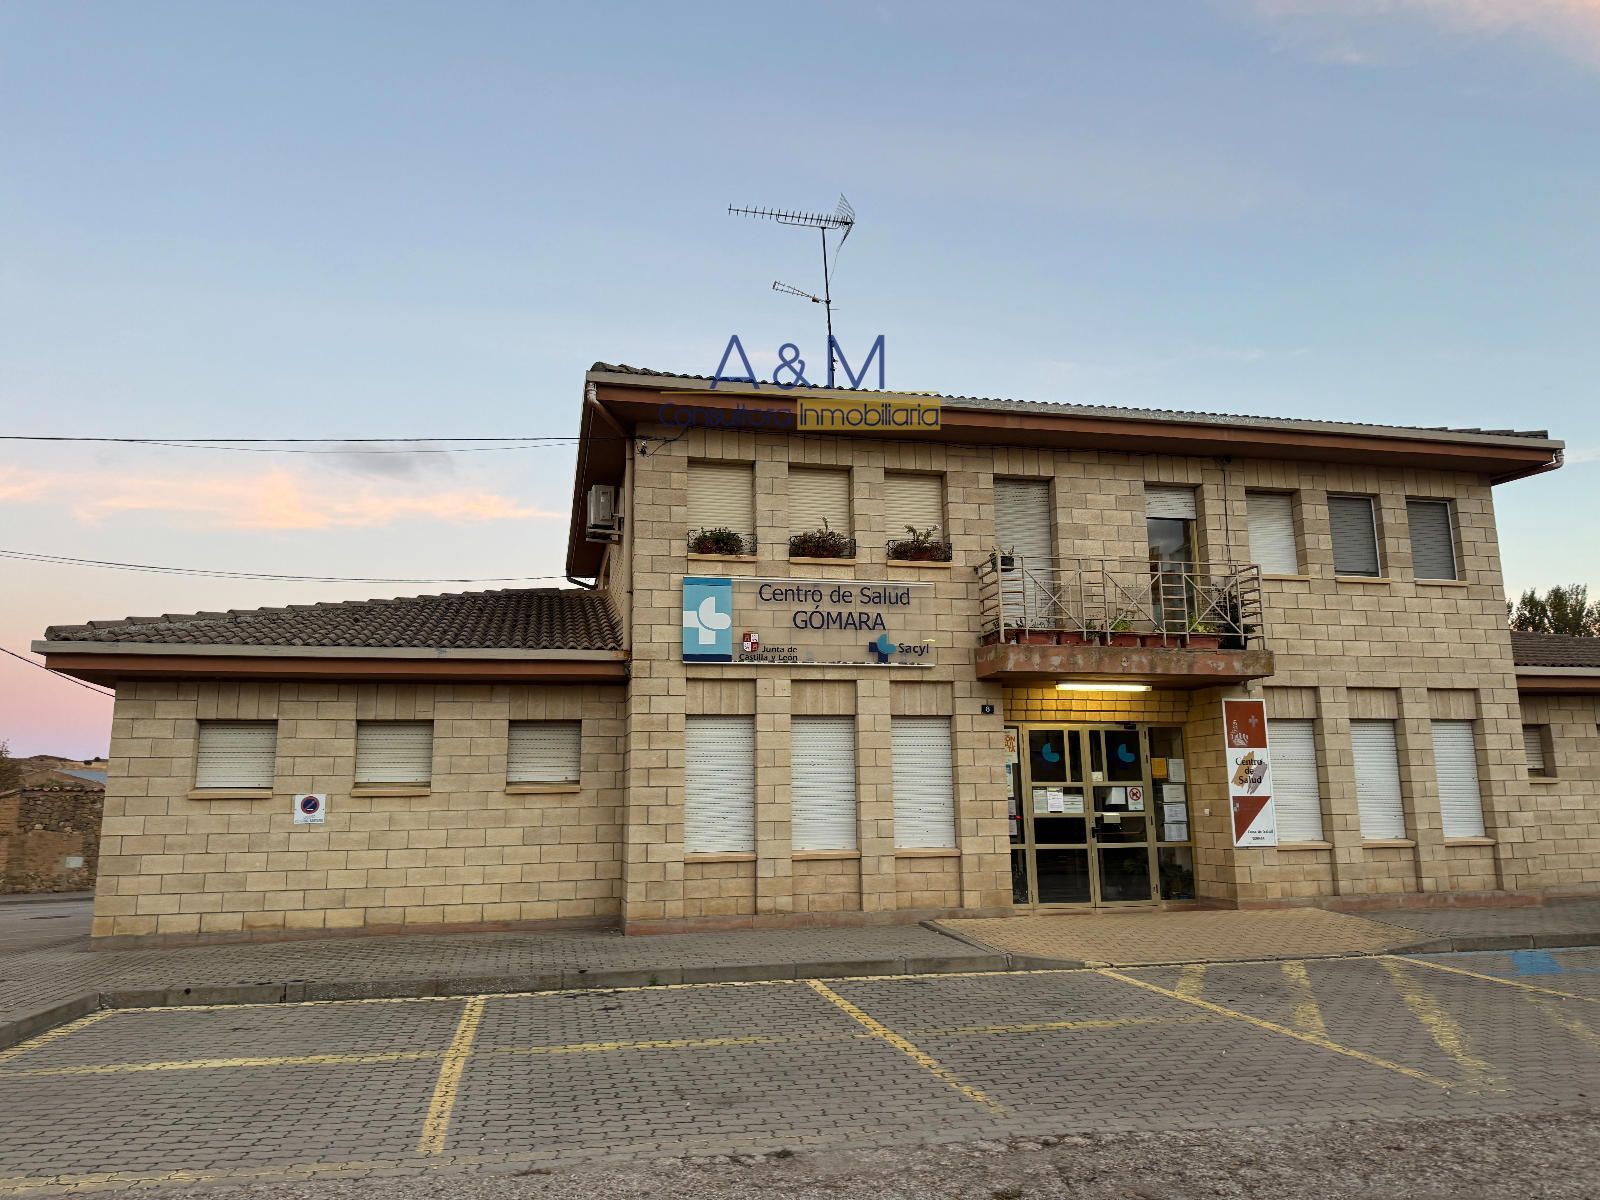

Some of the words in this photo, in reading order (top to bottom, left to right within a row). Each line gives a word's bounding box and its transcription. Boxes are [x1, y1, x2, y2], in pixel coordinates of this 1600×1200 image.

[759, 583, 823, 603] Centro
[829, 585, 853, 604] de
[860, 586, 910, 605] Salud
[793, 606, 886, 630] GÓMARA
[762, 645, 785, 653] Junta
[788, 645, 798, 653] de
[898, 642, 929, 656] Sacyl
[739, 653, 768, 661] Castilla
[778, 653, 798, 661] León
[1238, 776, 1262, 784] Salud
